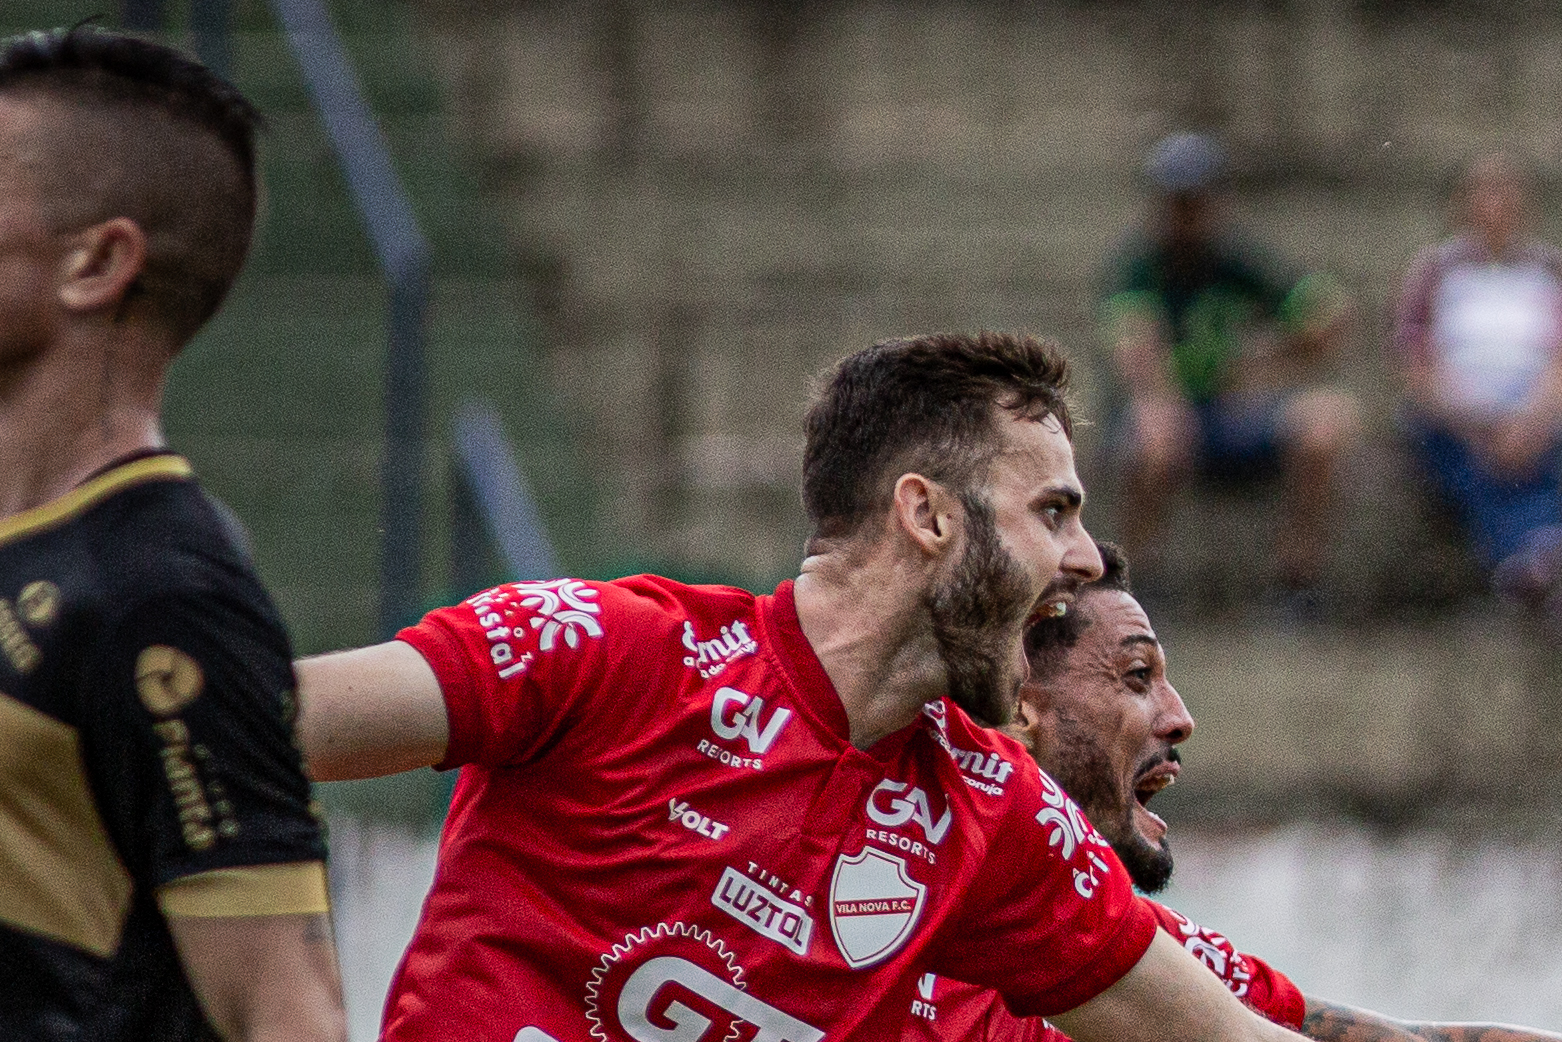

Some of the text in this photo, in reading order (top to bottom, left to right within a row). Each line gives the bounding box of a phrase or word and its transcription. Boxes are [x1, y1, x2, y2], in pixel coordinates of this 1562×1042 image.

[697, 738, 763, 770] REORTS
[668, 798, 729, 840] VOLT
[866, 829, 937, 865] RESORTS
[747, 861, 814, 907] TINTAS
[719, 876, 803, 947] LUZTOL
[836, 903, 857, 914] VILA
[858, 901, 890, 912] NOVA
